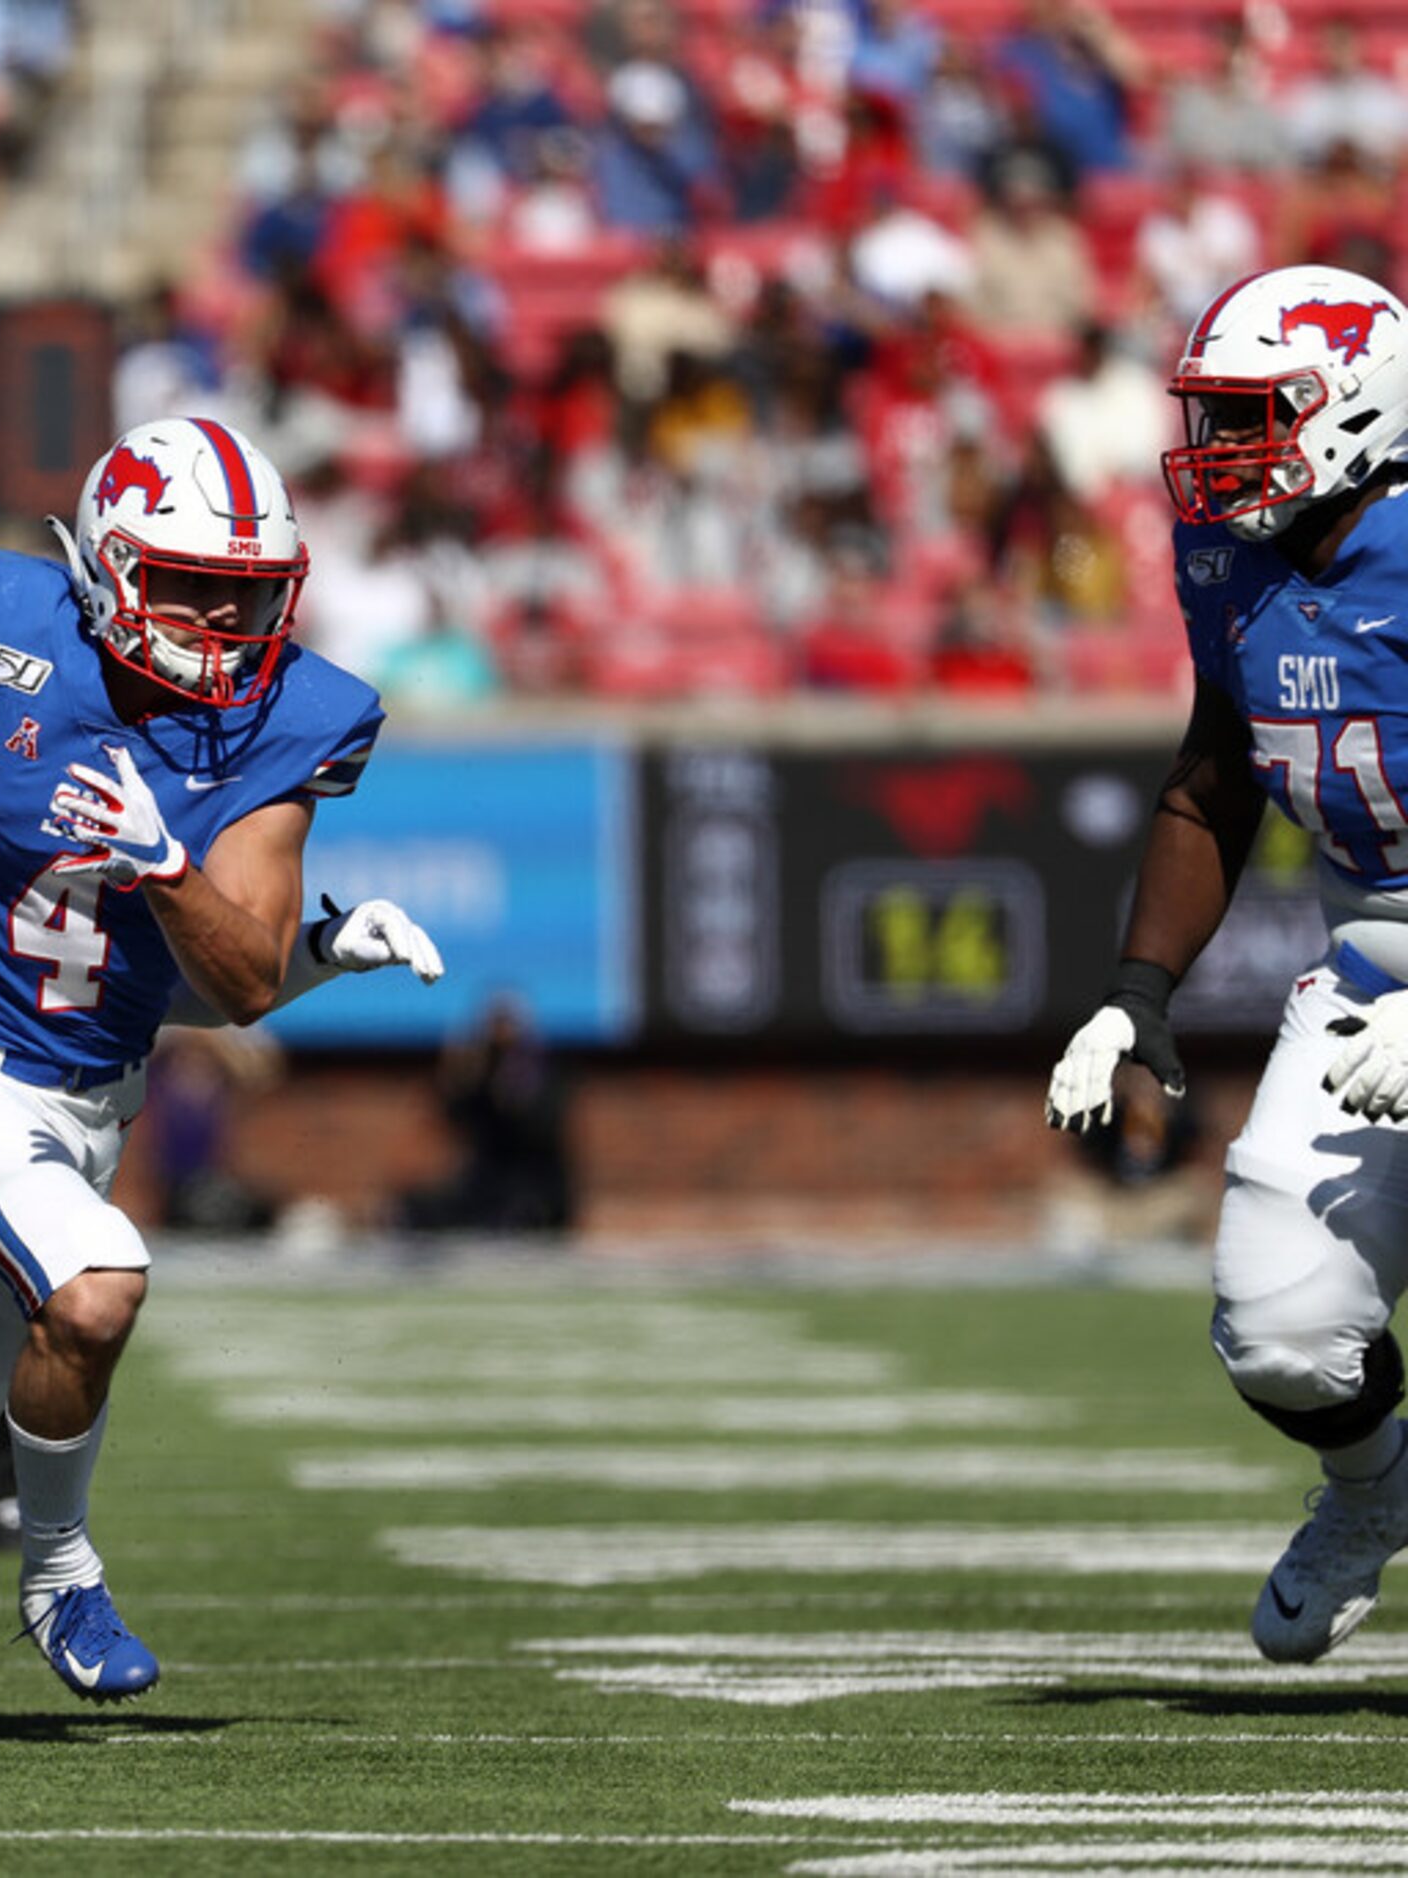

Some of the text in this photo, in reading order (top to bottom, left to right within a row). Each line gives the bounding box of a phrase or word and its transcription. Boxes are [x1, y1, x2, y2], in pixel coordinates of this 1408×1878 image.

[227, 541, 262, 556] SMU
[1278, 655, 1340, 711] SMU
[1249, 716, 1408, 876] 71
[7, 850, 111, 1014] 4
